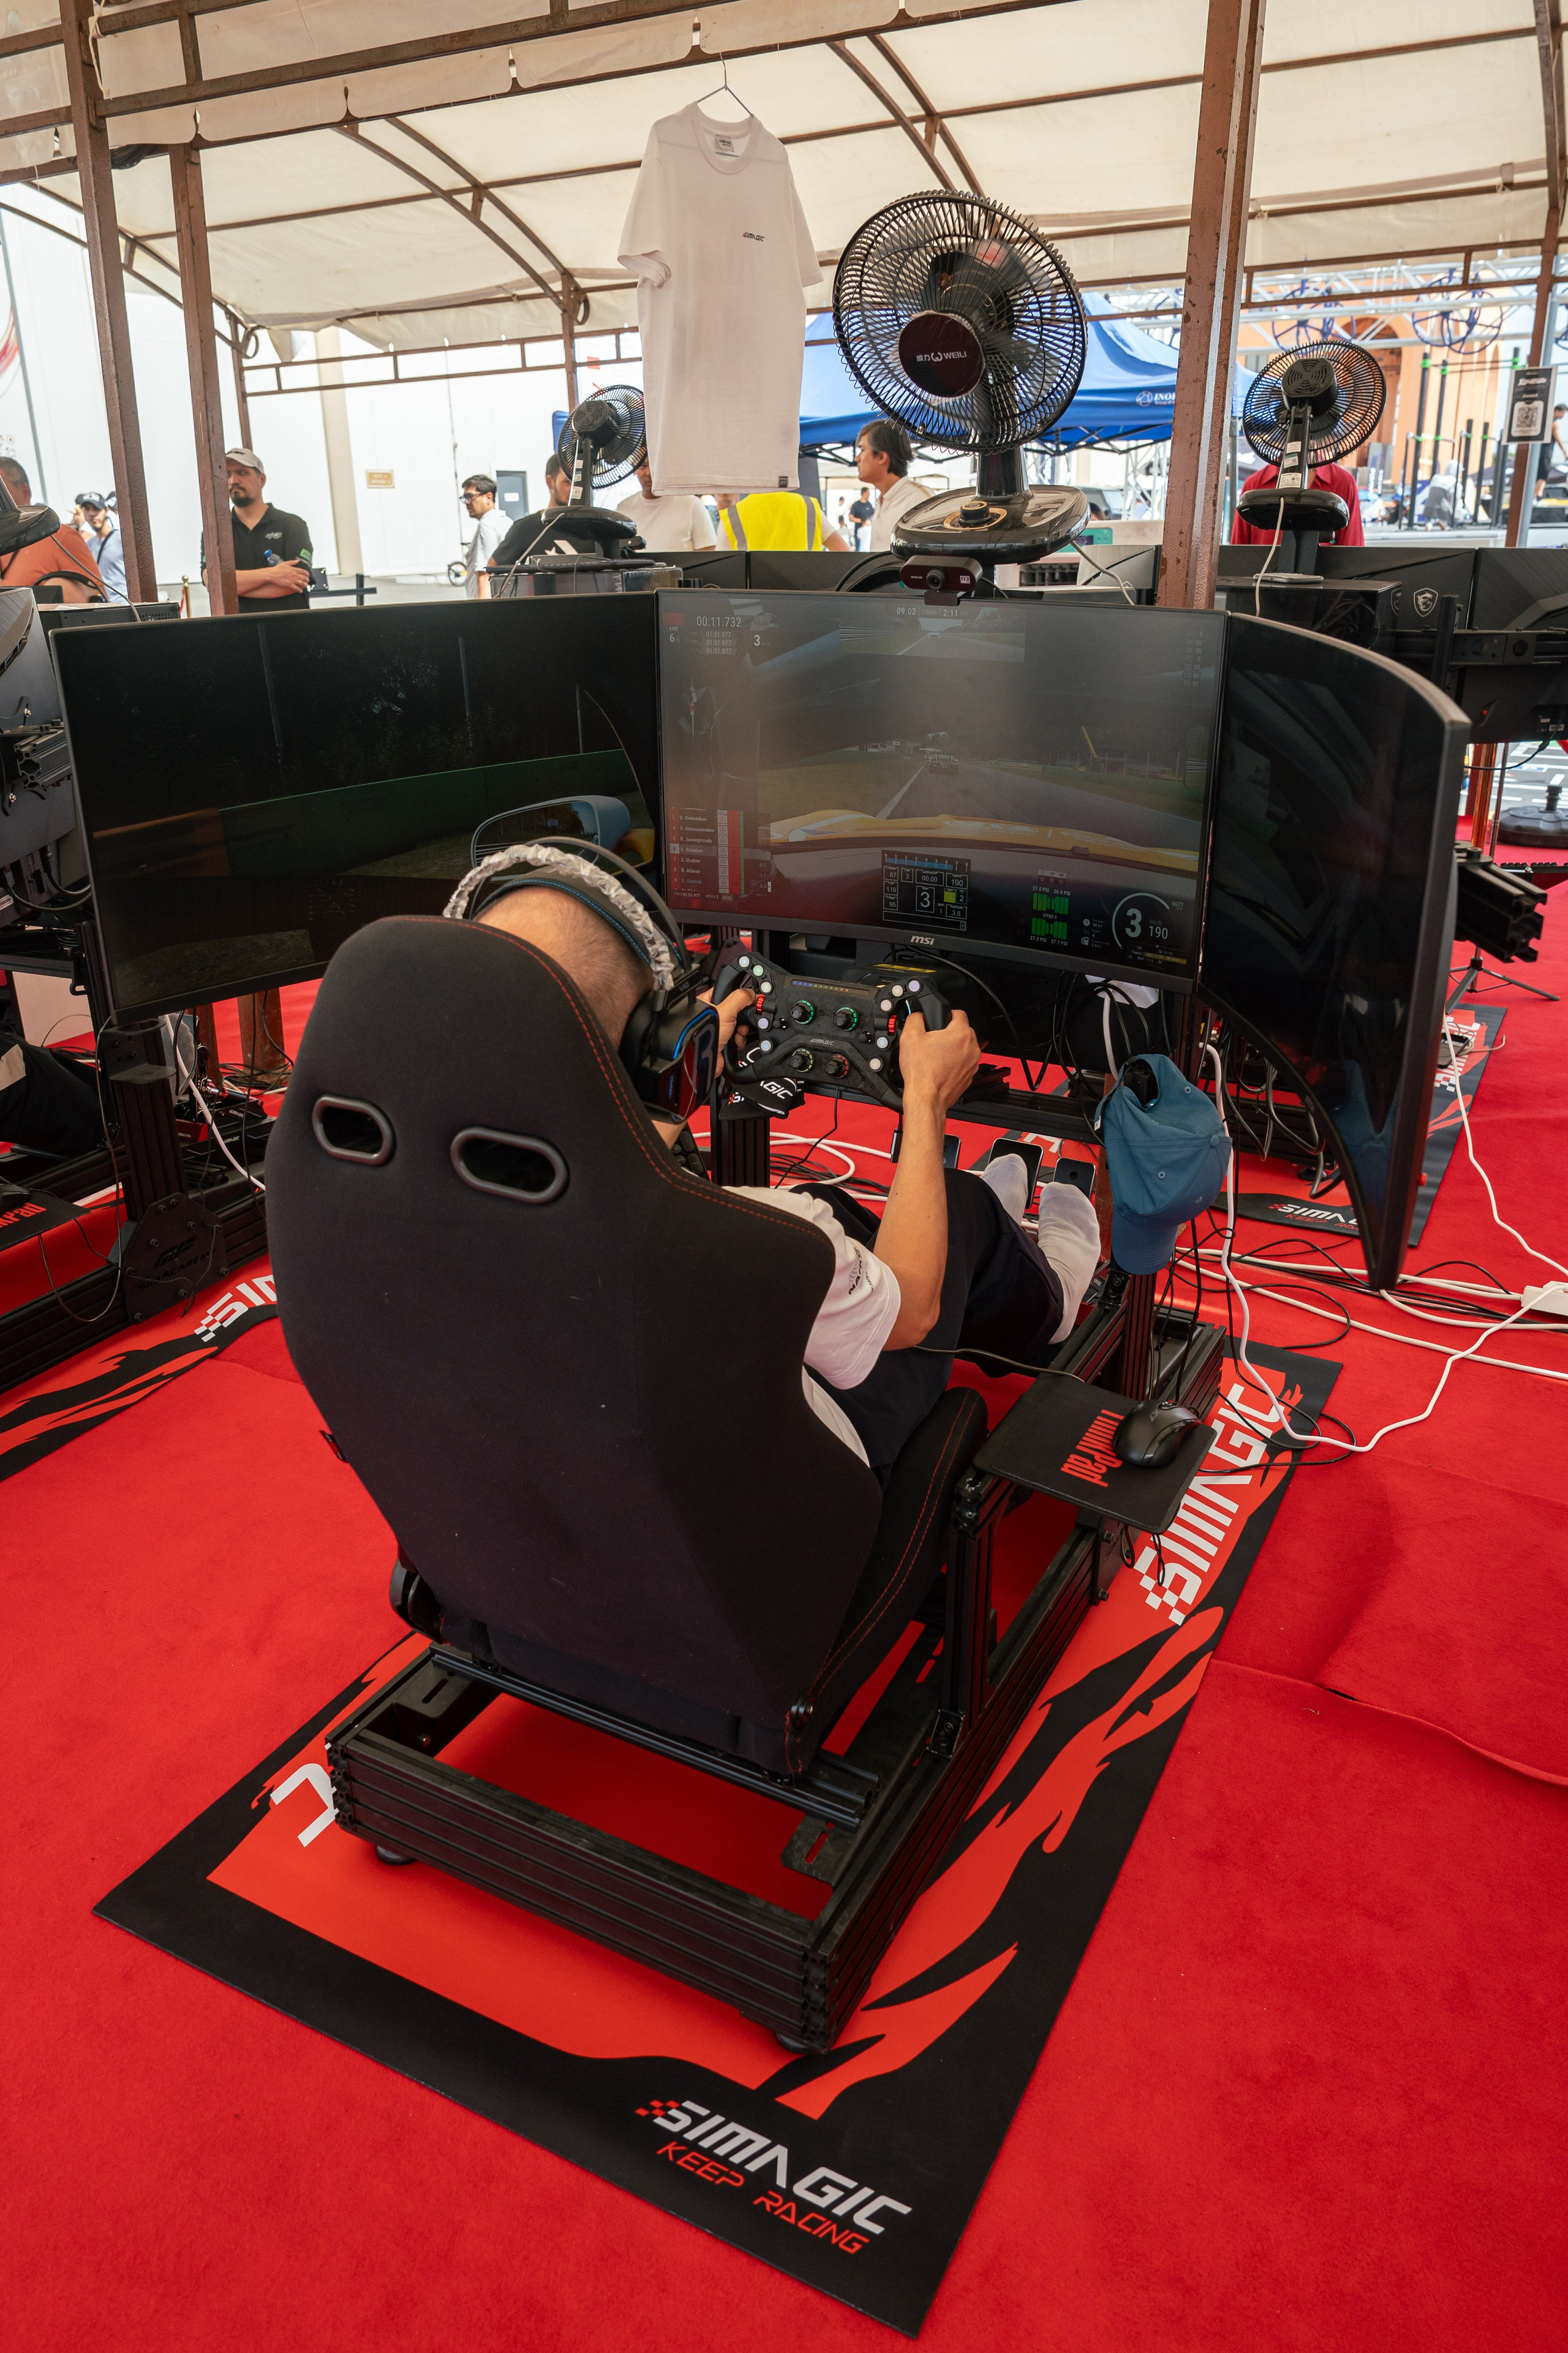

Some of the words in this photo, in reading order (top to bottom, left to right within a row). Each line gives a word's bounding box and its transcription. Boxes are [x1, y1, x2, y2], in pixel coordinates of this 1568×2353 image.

[742, 232, 765, 242] SIMAGIC
[943, 350, 967, 360] WEILI
[897, 607, 916, 616] 09:02
[943, 609, 959, 618] 2:11
[696, 616, 742, 628] 00:11.732
[753, 634, 761, 646] 3
[920, 891, 930, 908] 3
[1125, 908, 1142, 938] 3
[1149, 925, 1169, 940] 190
[910, 935, 935, 946] msi
[1285, 1214, 1328, 1224] KEEP
[1334, 1222, 1360, 1231] RA
[1134, 1383, 1285, 1626] SIMAGIC
[635, 2099, 912, 2235] SIMAGIC
[656, 2141, 745, 2188] KEEP
[752, 2190, 870, 2254] RACING
